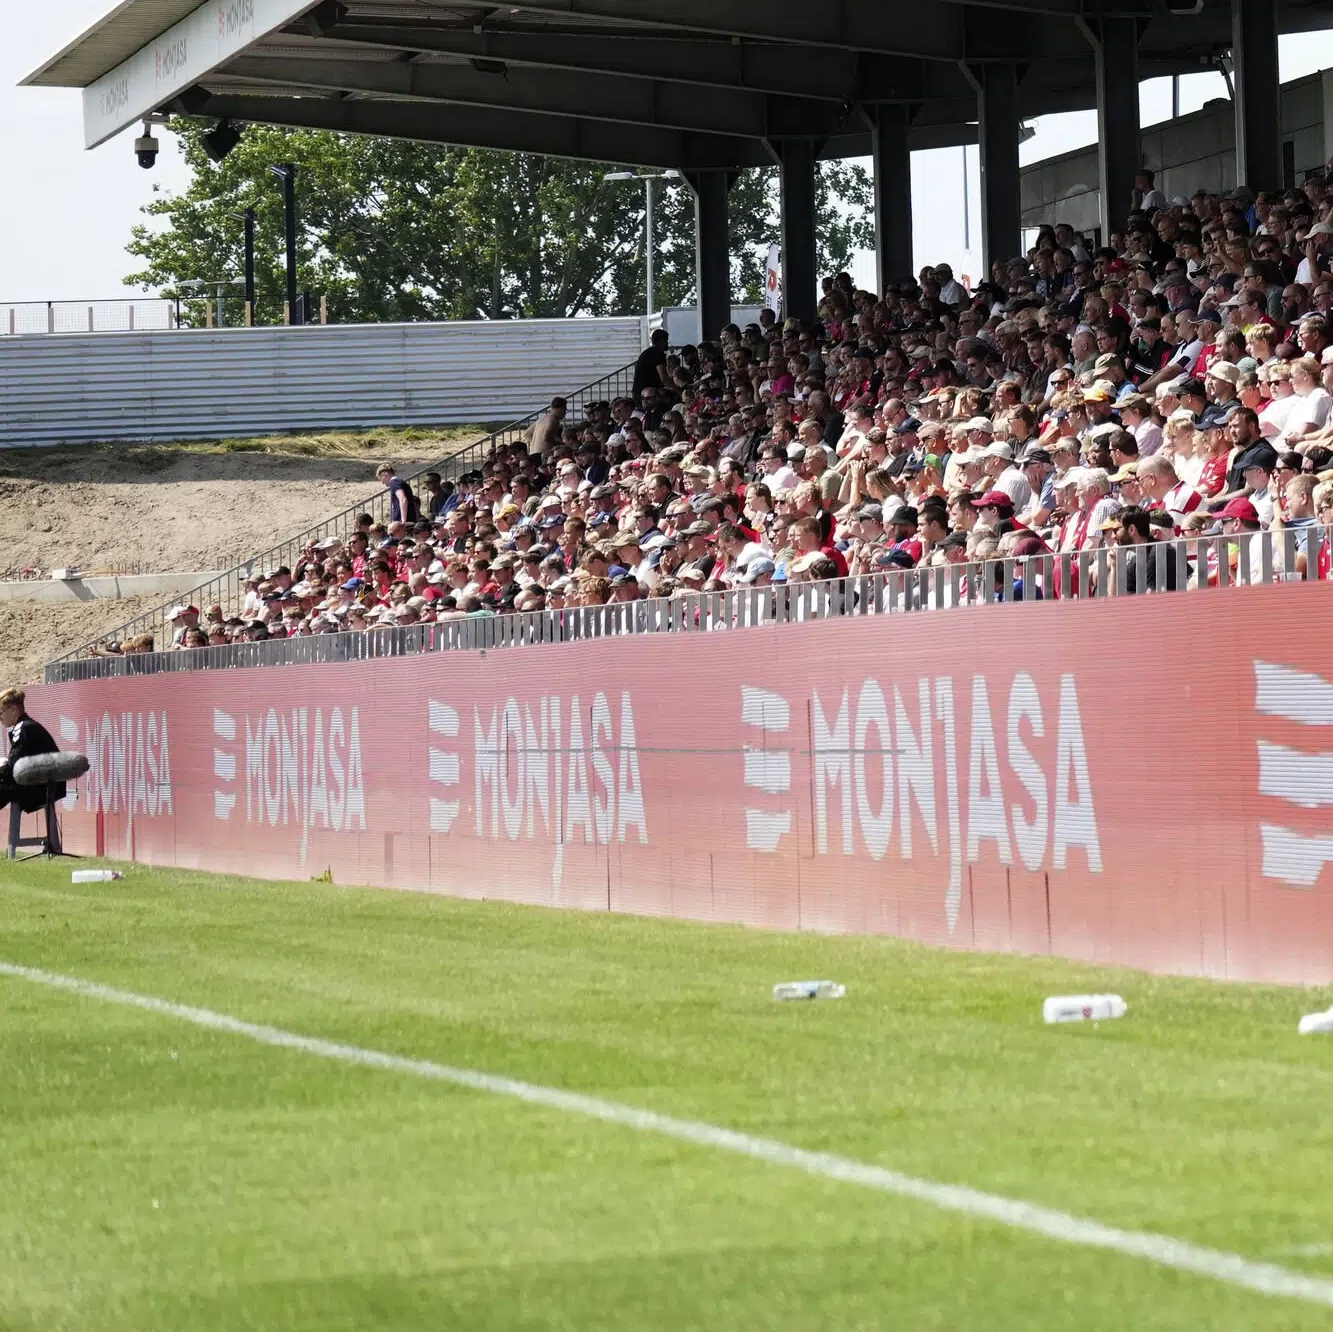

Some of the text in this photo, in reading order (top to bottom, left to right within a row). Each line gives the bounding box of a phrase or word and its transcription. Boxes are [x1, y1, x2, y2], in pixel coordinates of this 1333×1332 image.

[84, 709, 173, 863] MONJASA
[245, 706, 366, 867] MONJASA
[473, 691, 648, 899] MONJASA
[811, 672, 1103, 935] MONJASA
